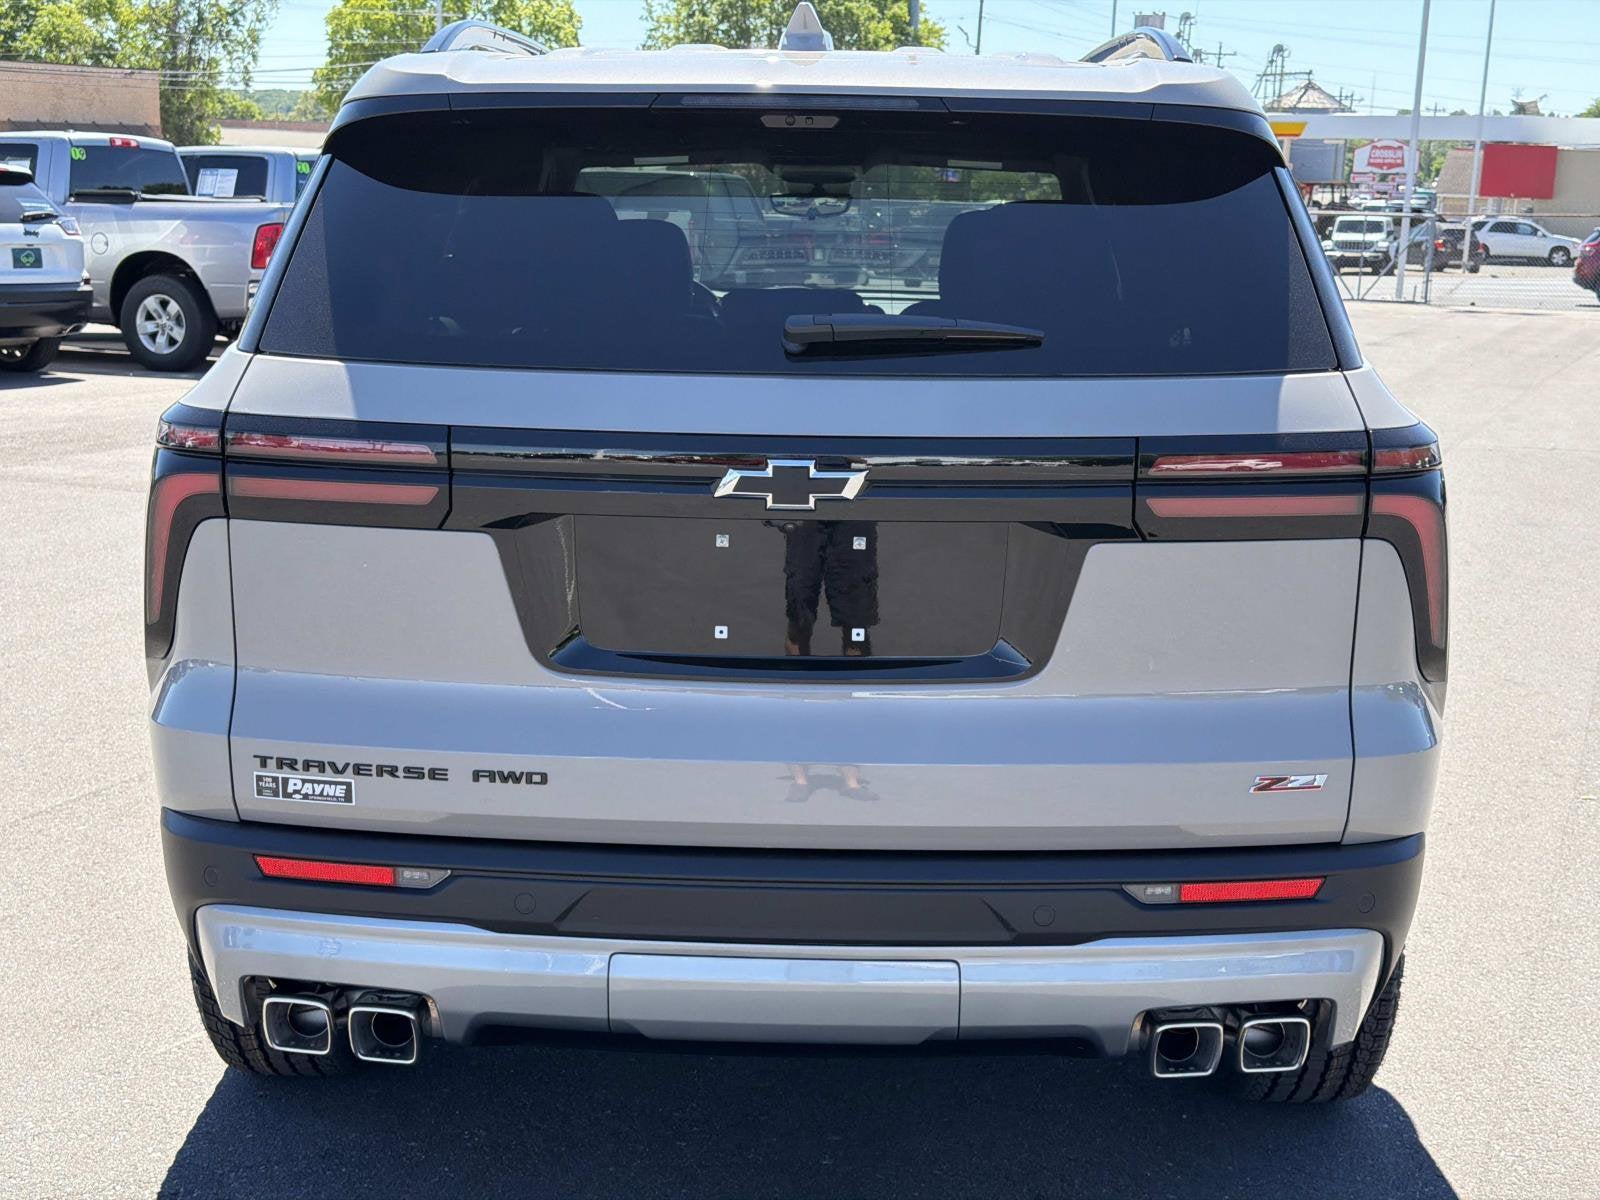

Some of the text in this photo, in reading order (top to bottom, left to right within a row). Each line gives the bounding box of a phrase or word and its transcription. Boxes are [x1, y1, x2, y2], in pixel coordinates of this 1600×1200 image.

[253, 754, 548, 786] TRAVERSE AWD
[1248, 774, 1329, 793] Z71
